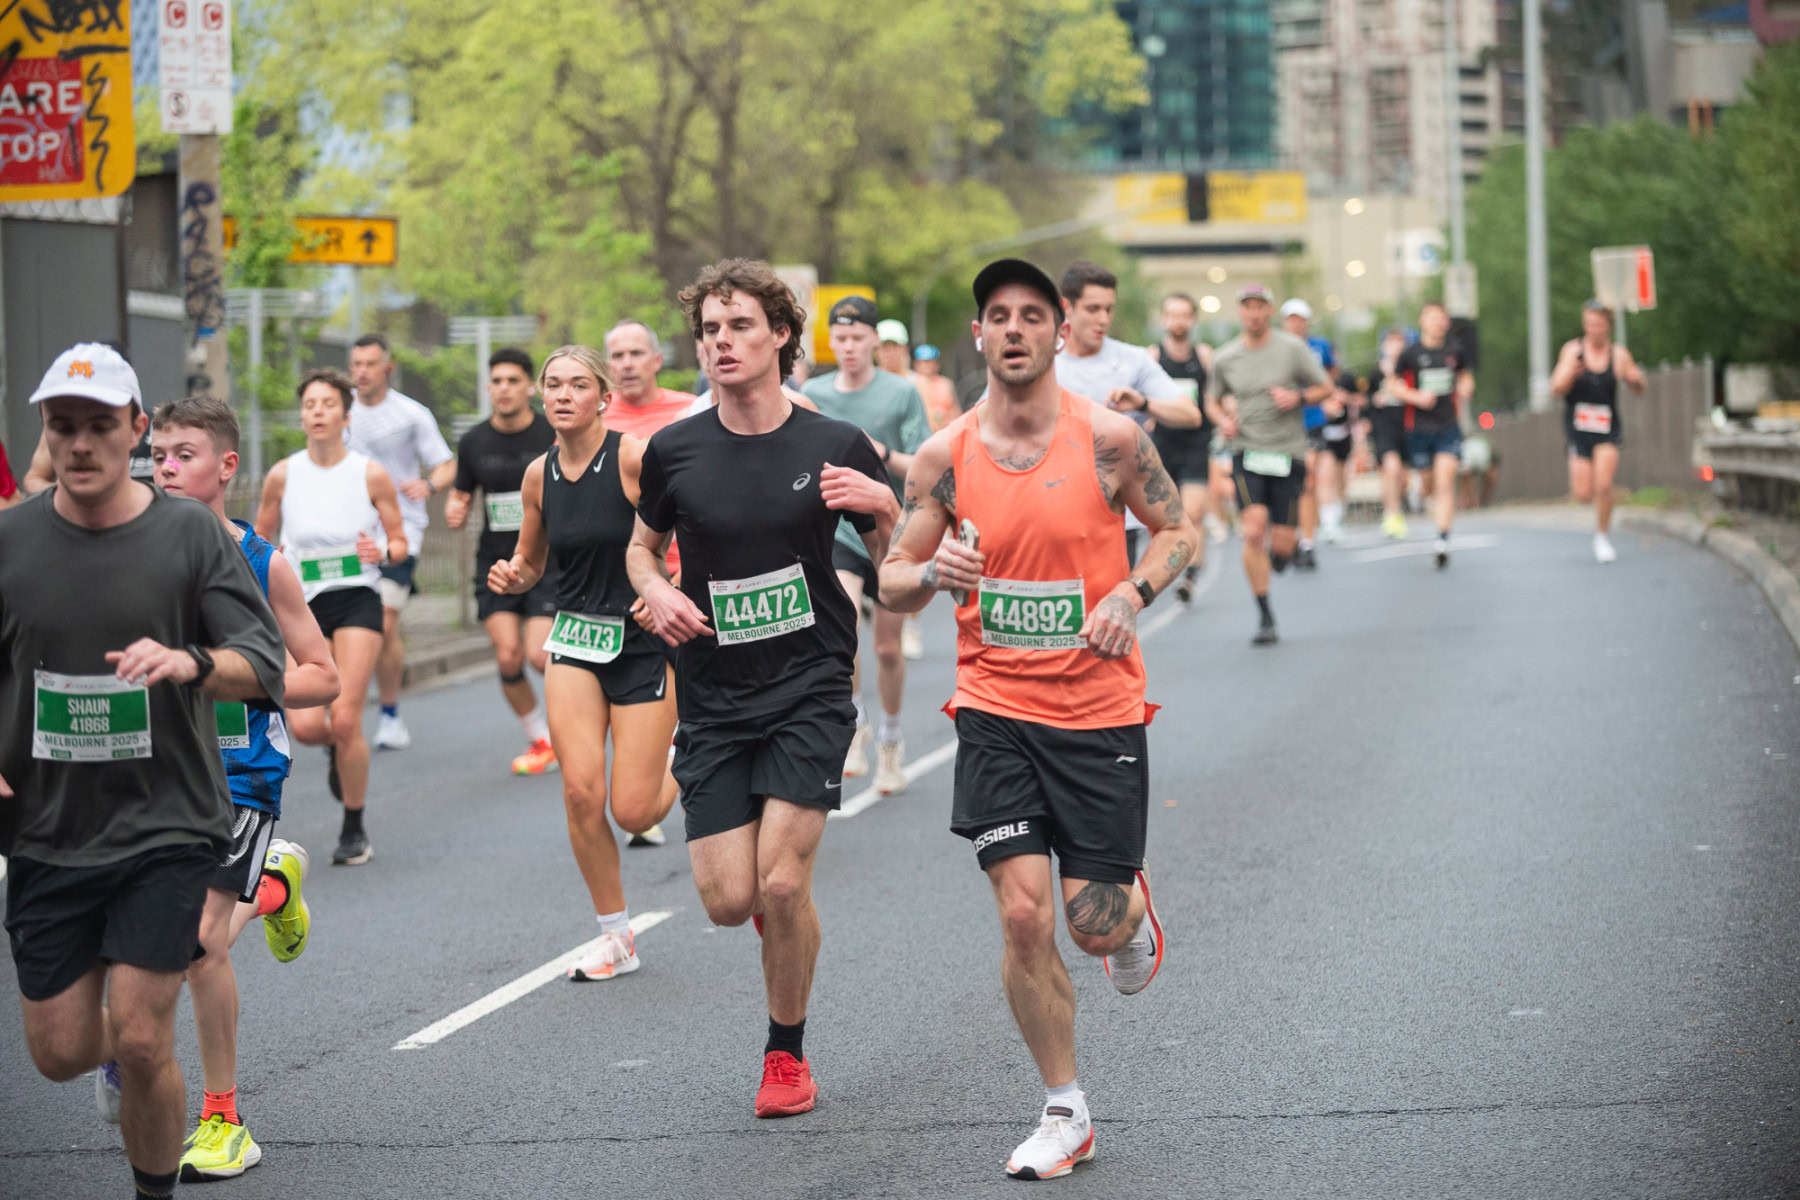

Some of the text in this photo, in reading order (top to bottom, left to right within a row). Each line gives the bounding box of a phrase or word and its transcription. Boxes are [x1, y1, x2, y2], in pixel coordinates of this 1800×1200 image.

[168, 2, 186, 27] C
[204, 4, 222, 29] C
[724, 584, 802, 627] 44472
[990, 597, 1073, 633] 44892
[558, 618, 615, 652] 44473
[727, 616, 807, 641] MELBOURNE 2025
[990, 633, 1076, 647] MELBOURNE 2025
[67, 697, 111, 715] SHAUN
[70, 716, 110, 734] 41868
[44, 734, 140, 748] MELBOURNE 2025
[219, 737, 240, 747] 025
